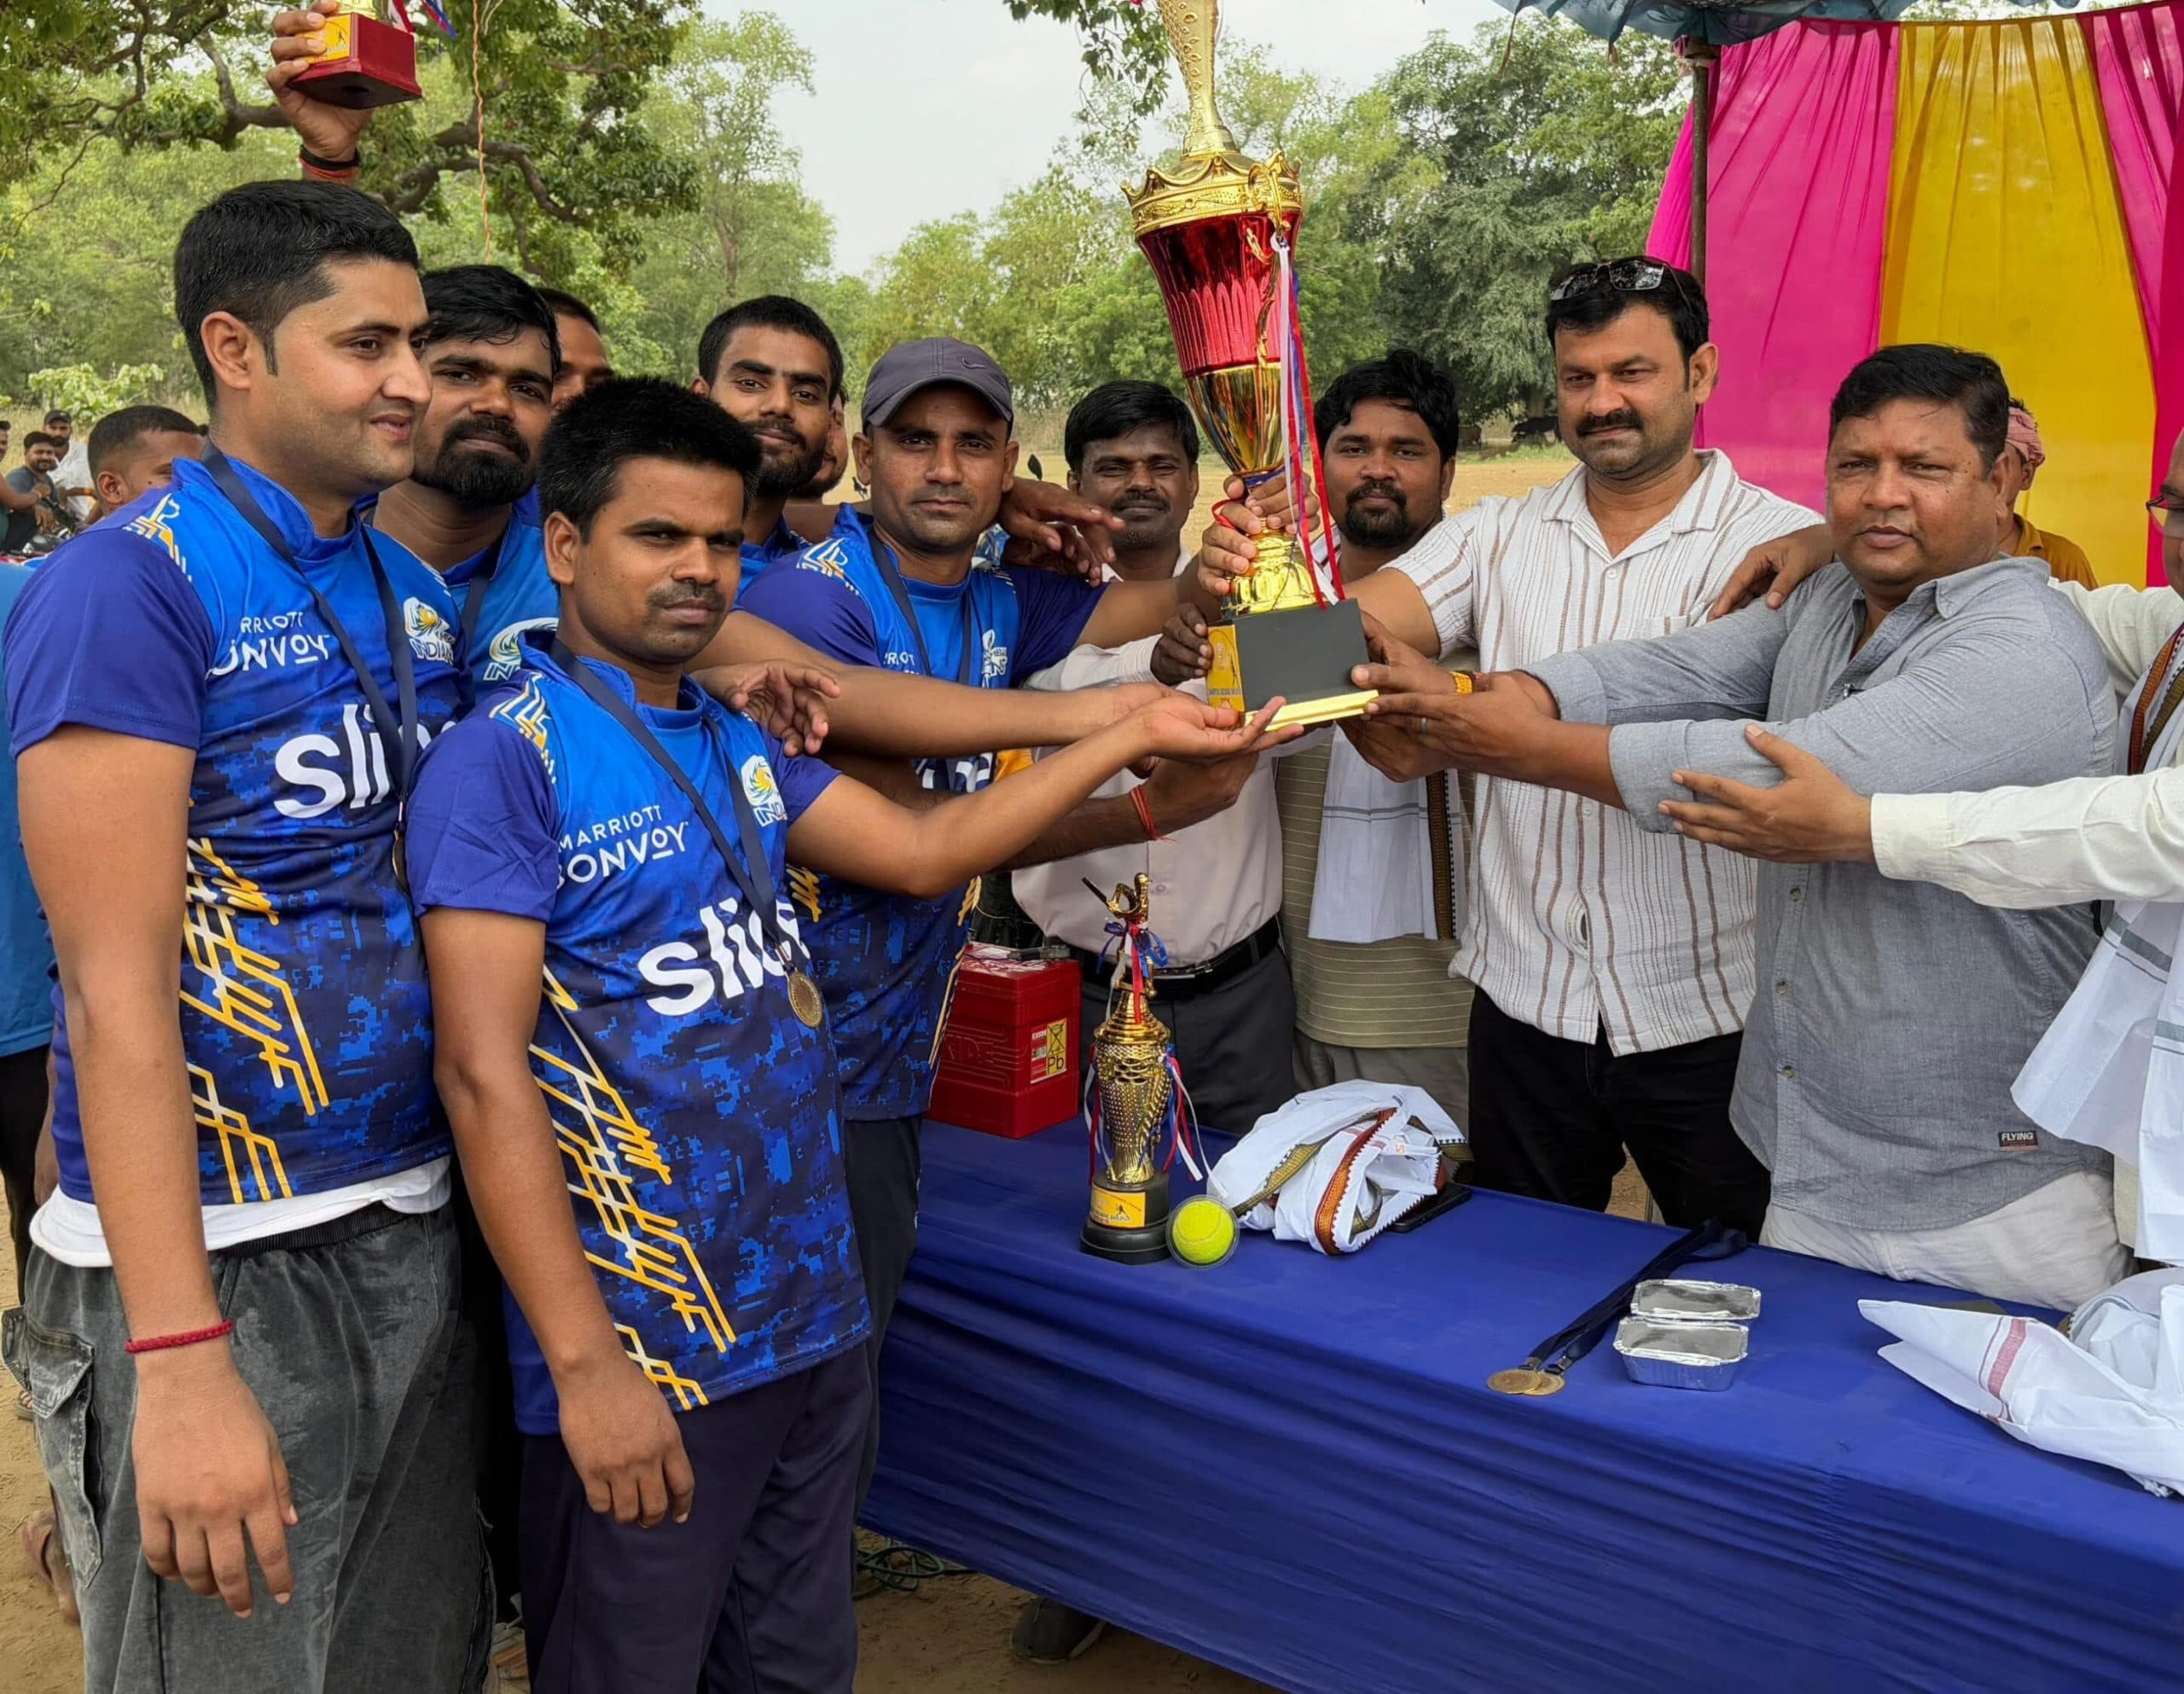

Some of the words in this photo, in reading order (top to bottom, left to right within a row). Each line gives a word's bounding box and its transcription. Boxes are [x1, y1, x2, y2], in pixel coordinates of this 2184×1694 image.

[240, 611, 304, 634] RRIOTT
[558, 804, 662, 853] MARRIOTT
[1047, 1054, 1065, 1075] Pb
[2001, 1132, 2035, 1141] FLYING
